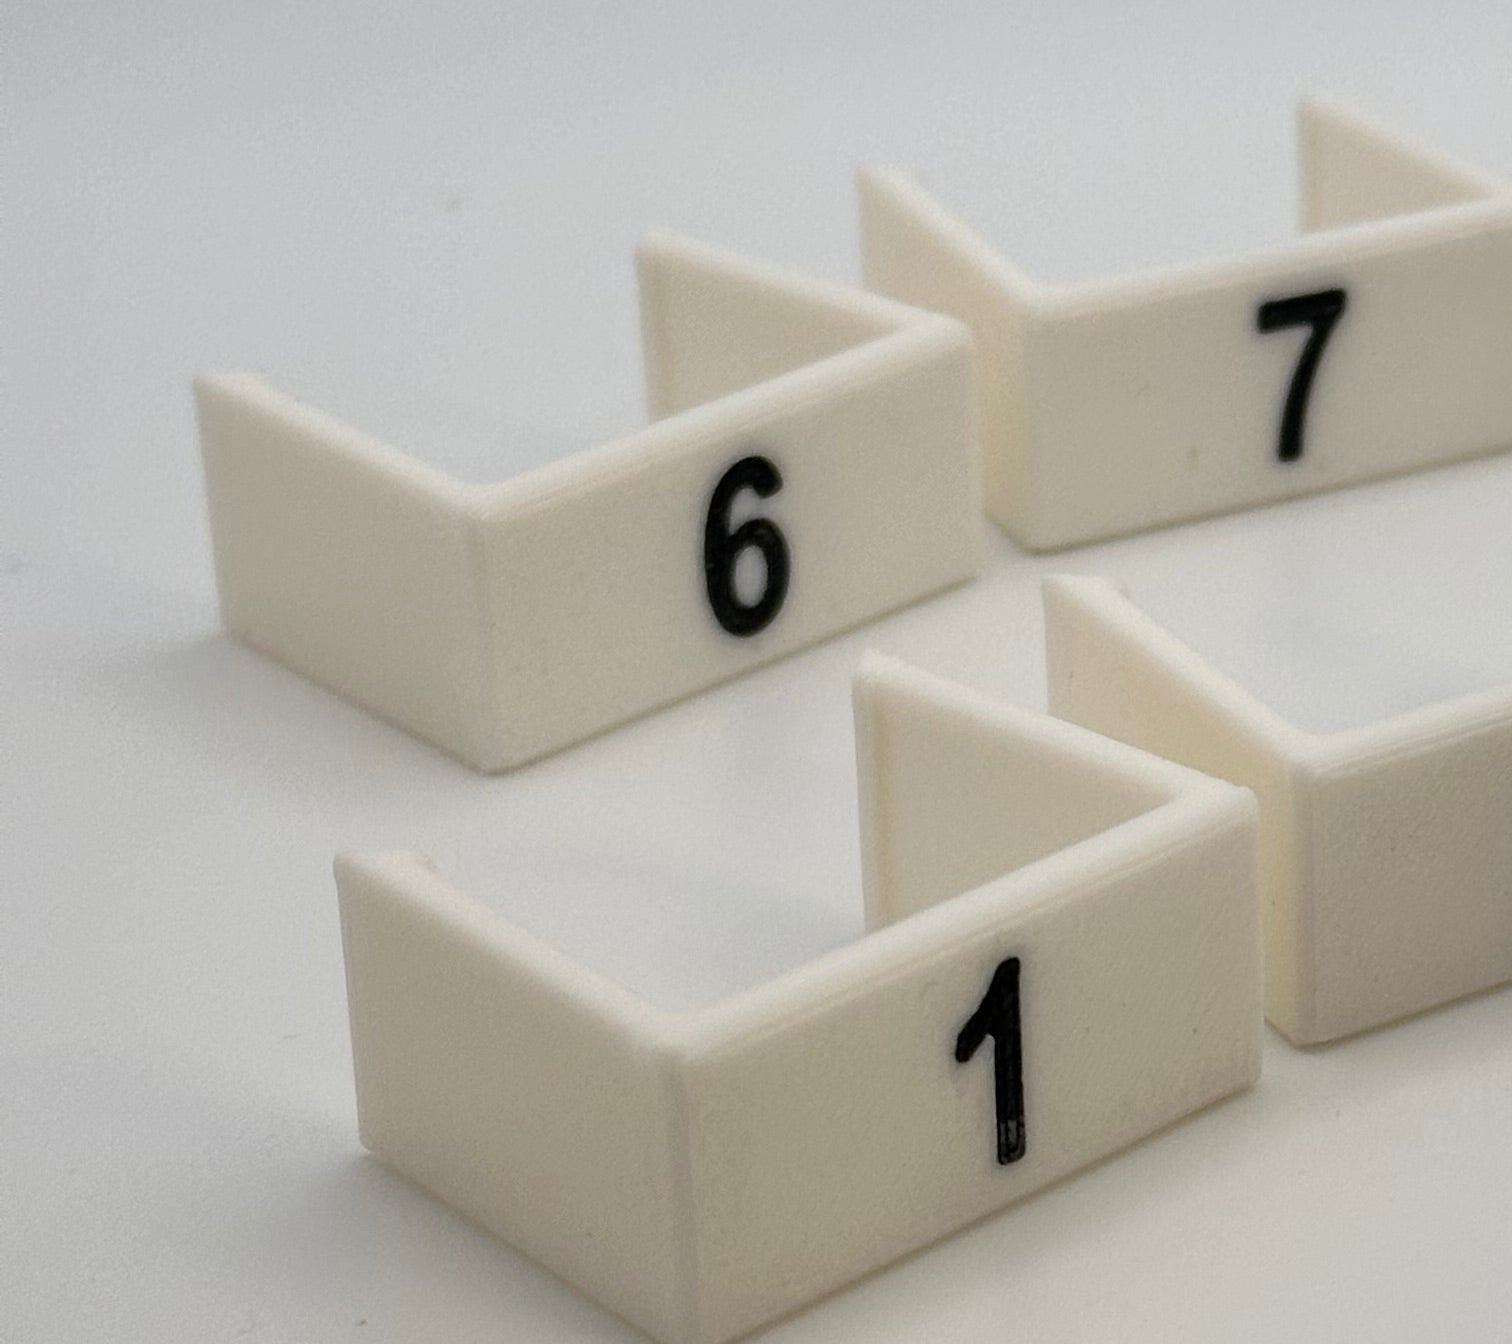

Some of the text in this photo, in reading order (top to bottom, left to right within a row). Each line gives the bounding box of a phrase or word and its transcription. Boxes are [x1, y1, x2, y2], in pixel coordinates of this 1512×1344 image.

[1254, 285, 1350, 465] 7
[700, 453, 792, 640] 6
[951, 954, 1028, 1168] 1
